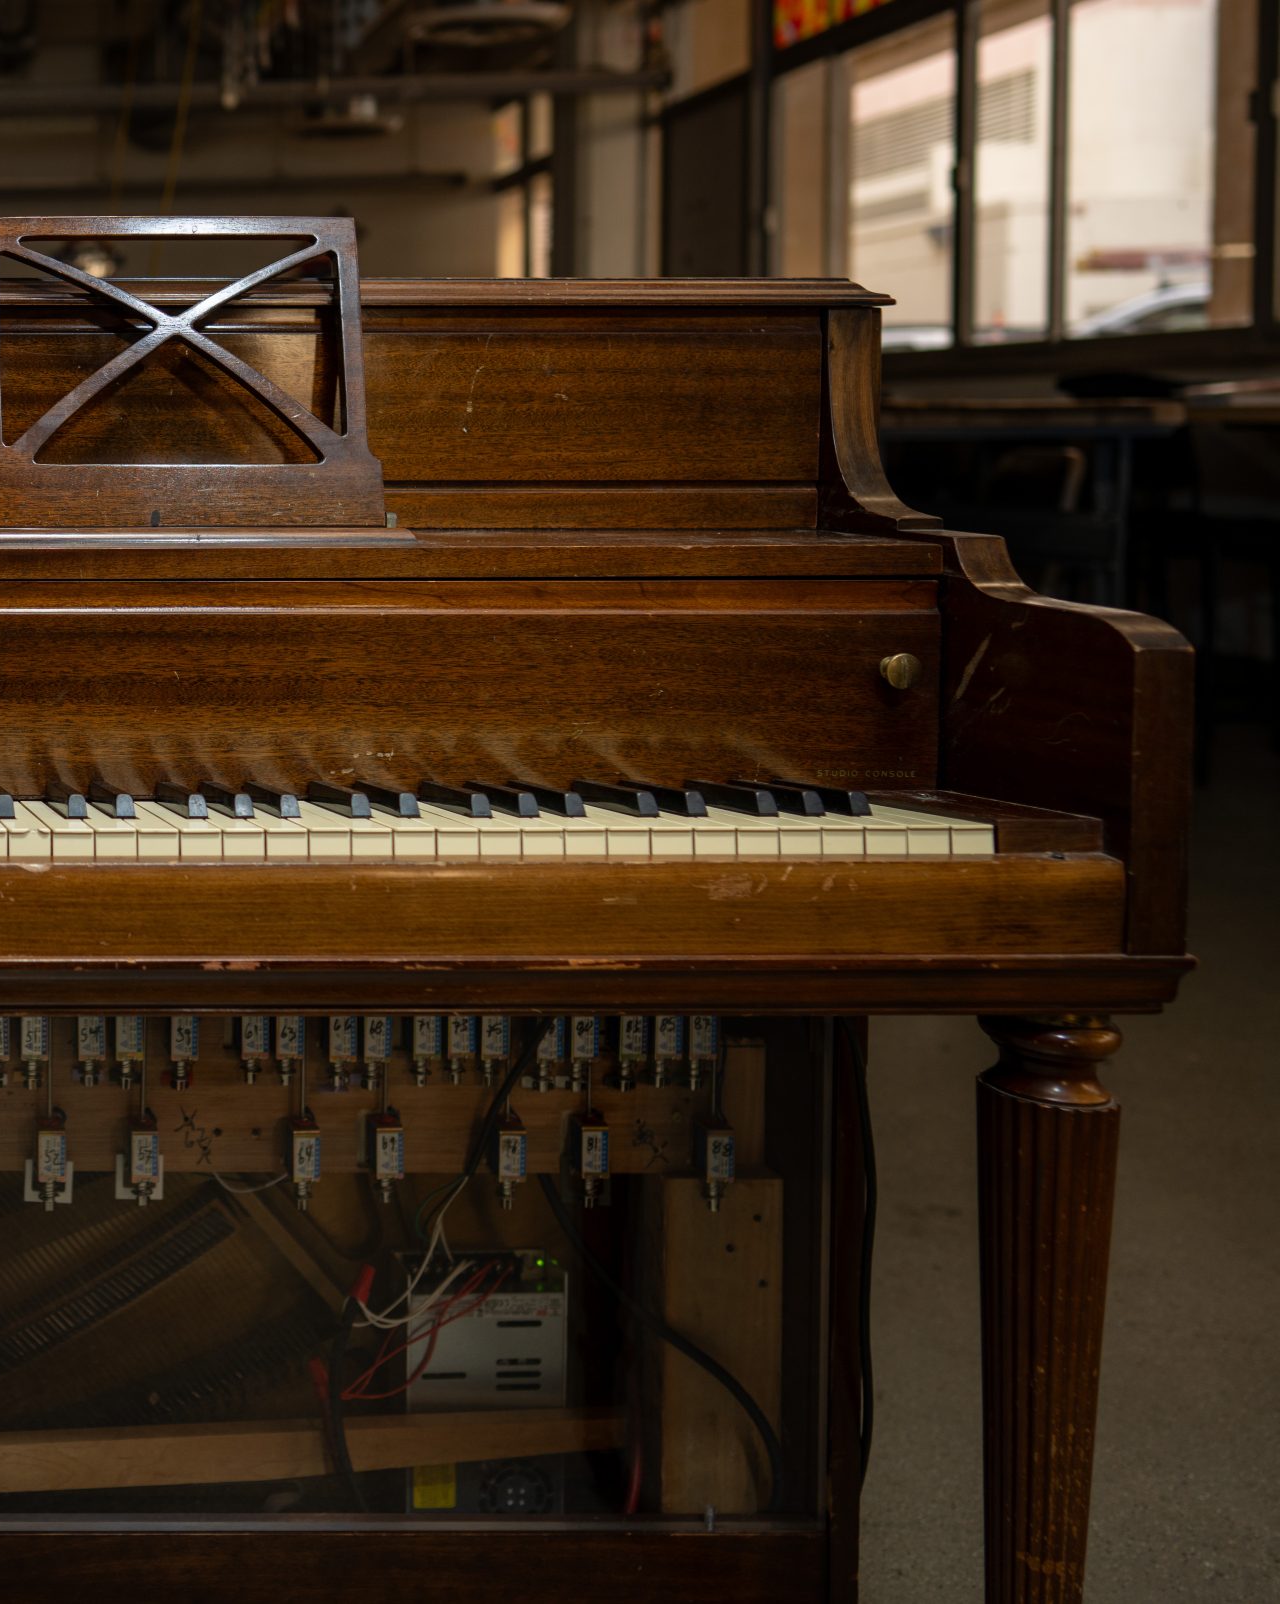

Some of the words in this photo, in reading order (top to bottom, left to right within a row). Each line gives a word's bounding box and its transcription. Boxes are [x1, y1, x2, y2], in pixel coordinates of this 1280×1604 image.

[816, 769, 859, 778] STUDIO
[865, 769, 917, 778] CONSOLE
[694, 1016, 711, 1031] 87
[281, 1026, 297, 1042] 63
